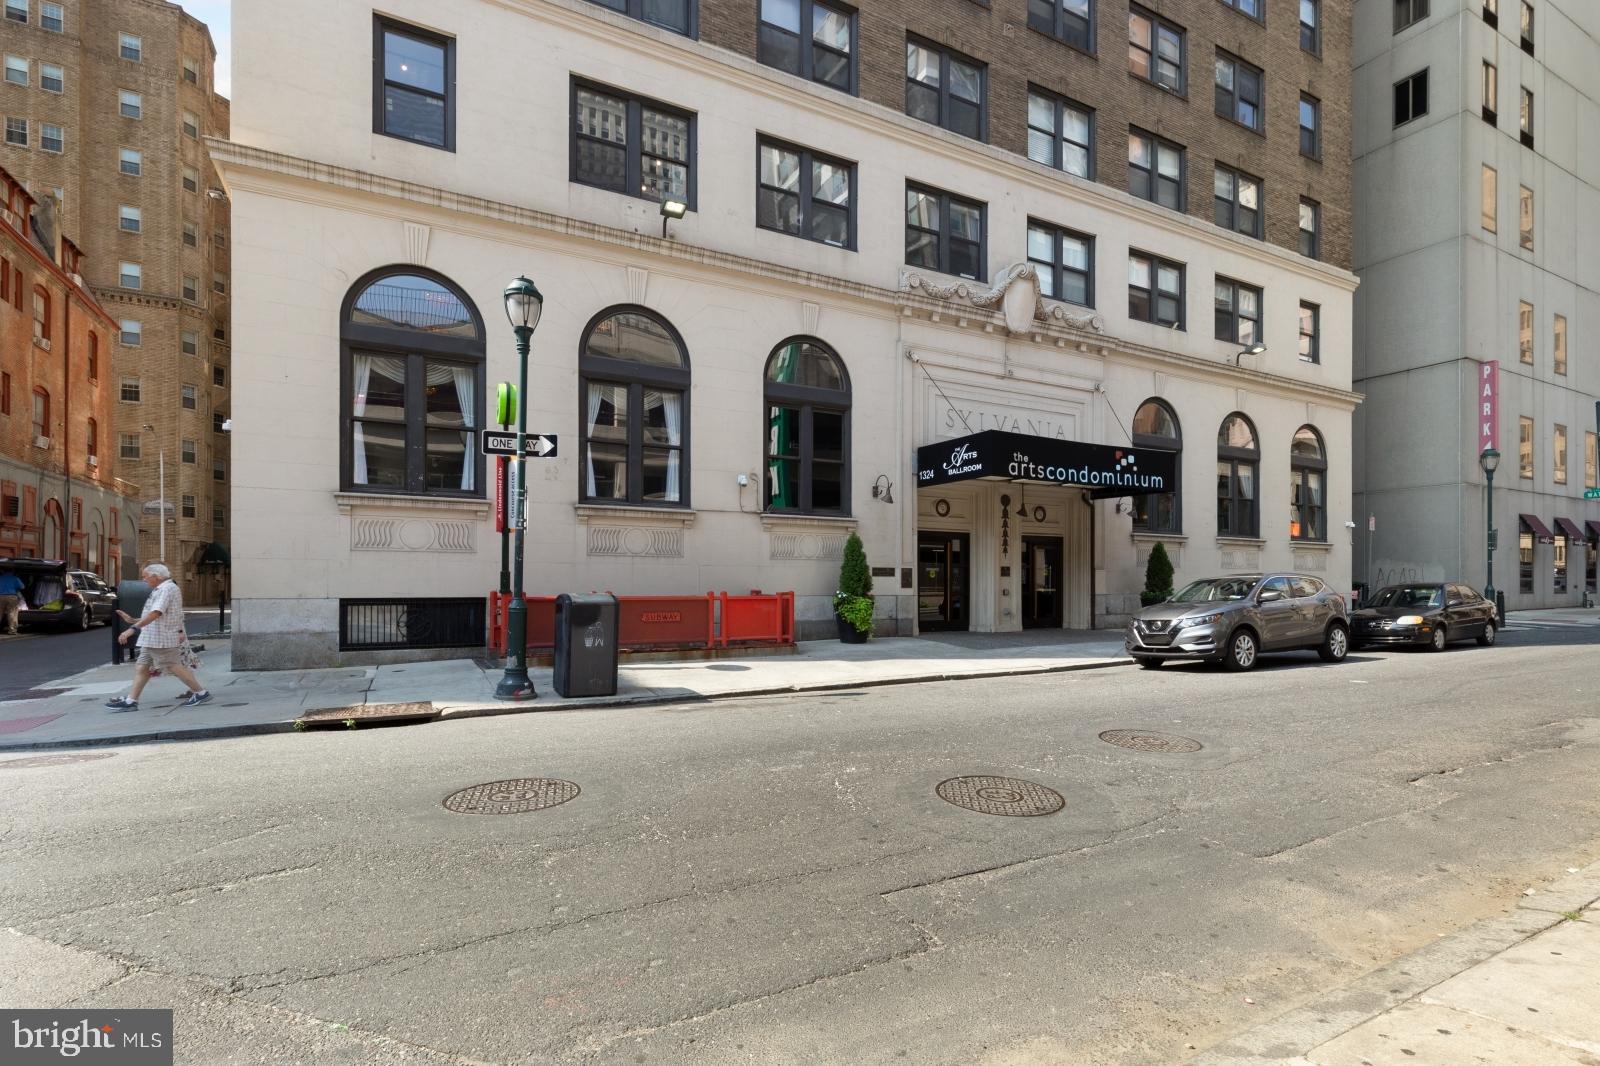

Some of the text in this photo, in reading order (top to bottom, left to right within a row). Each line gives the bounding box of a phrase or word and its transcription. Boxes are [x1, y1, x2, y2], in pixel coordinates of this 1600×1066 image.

[1483, 365, 1492, 436] PARK
[491, 438, 538, 450] ONE AY
[943, 444, 978, 469] ARTS
[1013, 452, 1029, 463] the
[919, 469, 935, 480] 1324
[948, 463, 982, 476] BALLROOM
[1008, 461, 1163, 489] artscondominium
